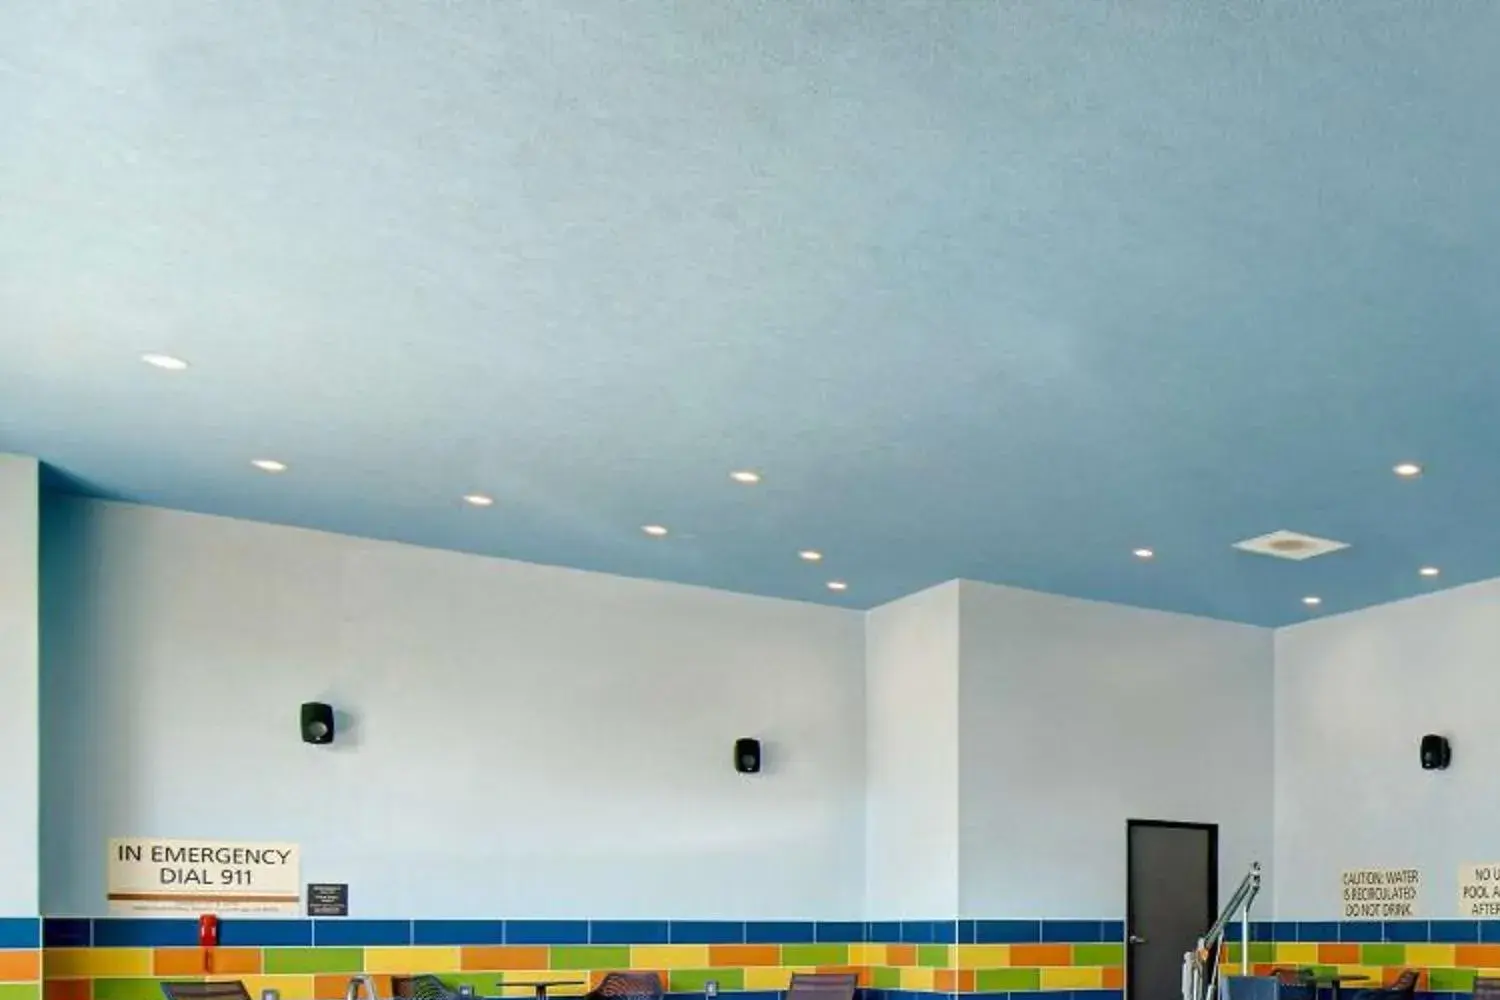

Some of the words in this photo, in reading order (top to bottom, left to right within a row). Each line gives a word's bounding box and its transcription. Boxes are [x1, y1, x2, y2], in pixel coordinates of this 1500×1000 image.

[118, 845, 142, 861] IN
[150, 845, 292, 865] EMERGENCY
[160, 867, 214, 885] DIAL
[220, 868, 252, 886] 911
[1385, 869, 1419, 884] WATER
[1475, 867, 1490, 881] NO
[1463, 884, 1490, 899] POOL
[1345, 903, 1360, 917] DO
[1361, 903, 1381, 917] NOT
